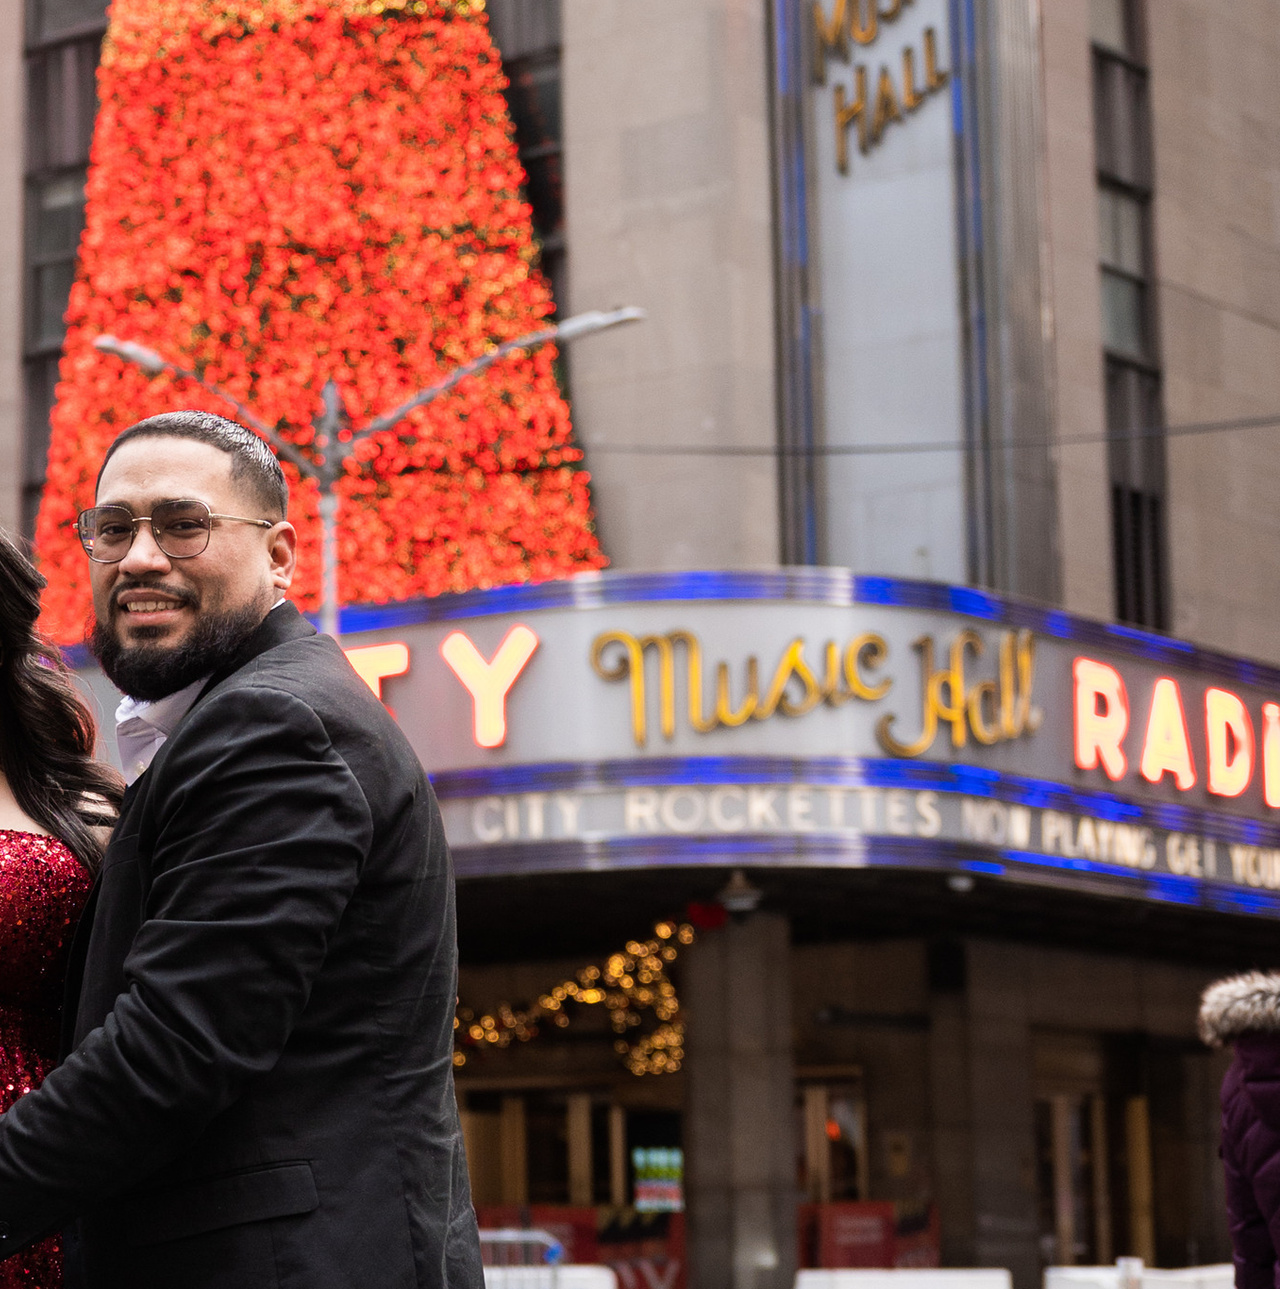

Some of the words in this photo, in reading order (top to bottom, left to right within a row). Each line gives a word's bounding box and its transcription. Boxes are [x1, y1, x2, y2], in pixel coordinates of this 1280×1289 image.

[590, 629, 893, 747] Music
[876, 630, 1036, 758] Hall
[472, 794, 583, 843] CITY
[625, 785, 942, 837] ROCKETTES
[1040, 809, 1157, 870] PLAYING
